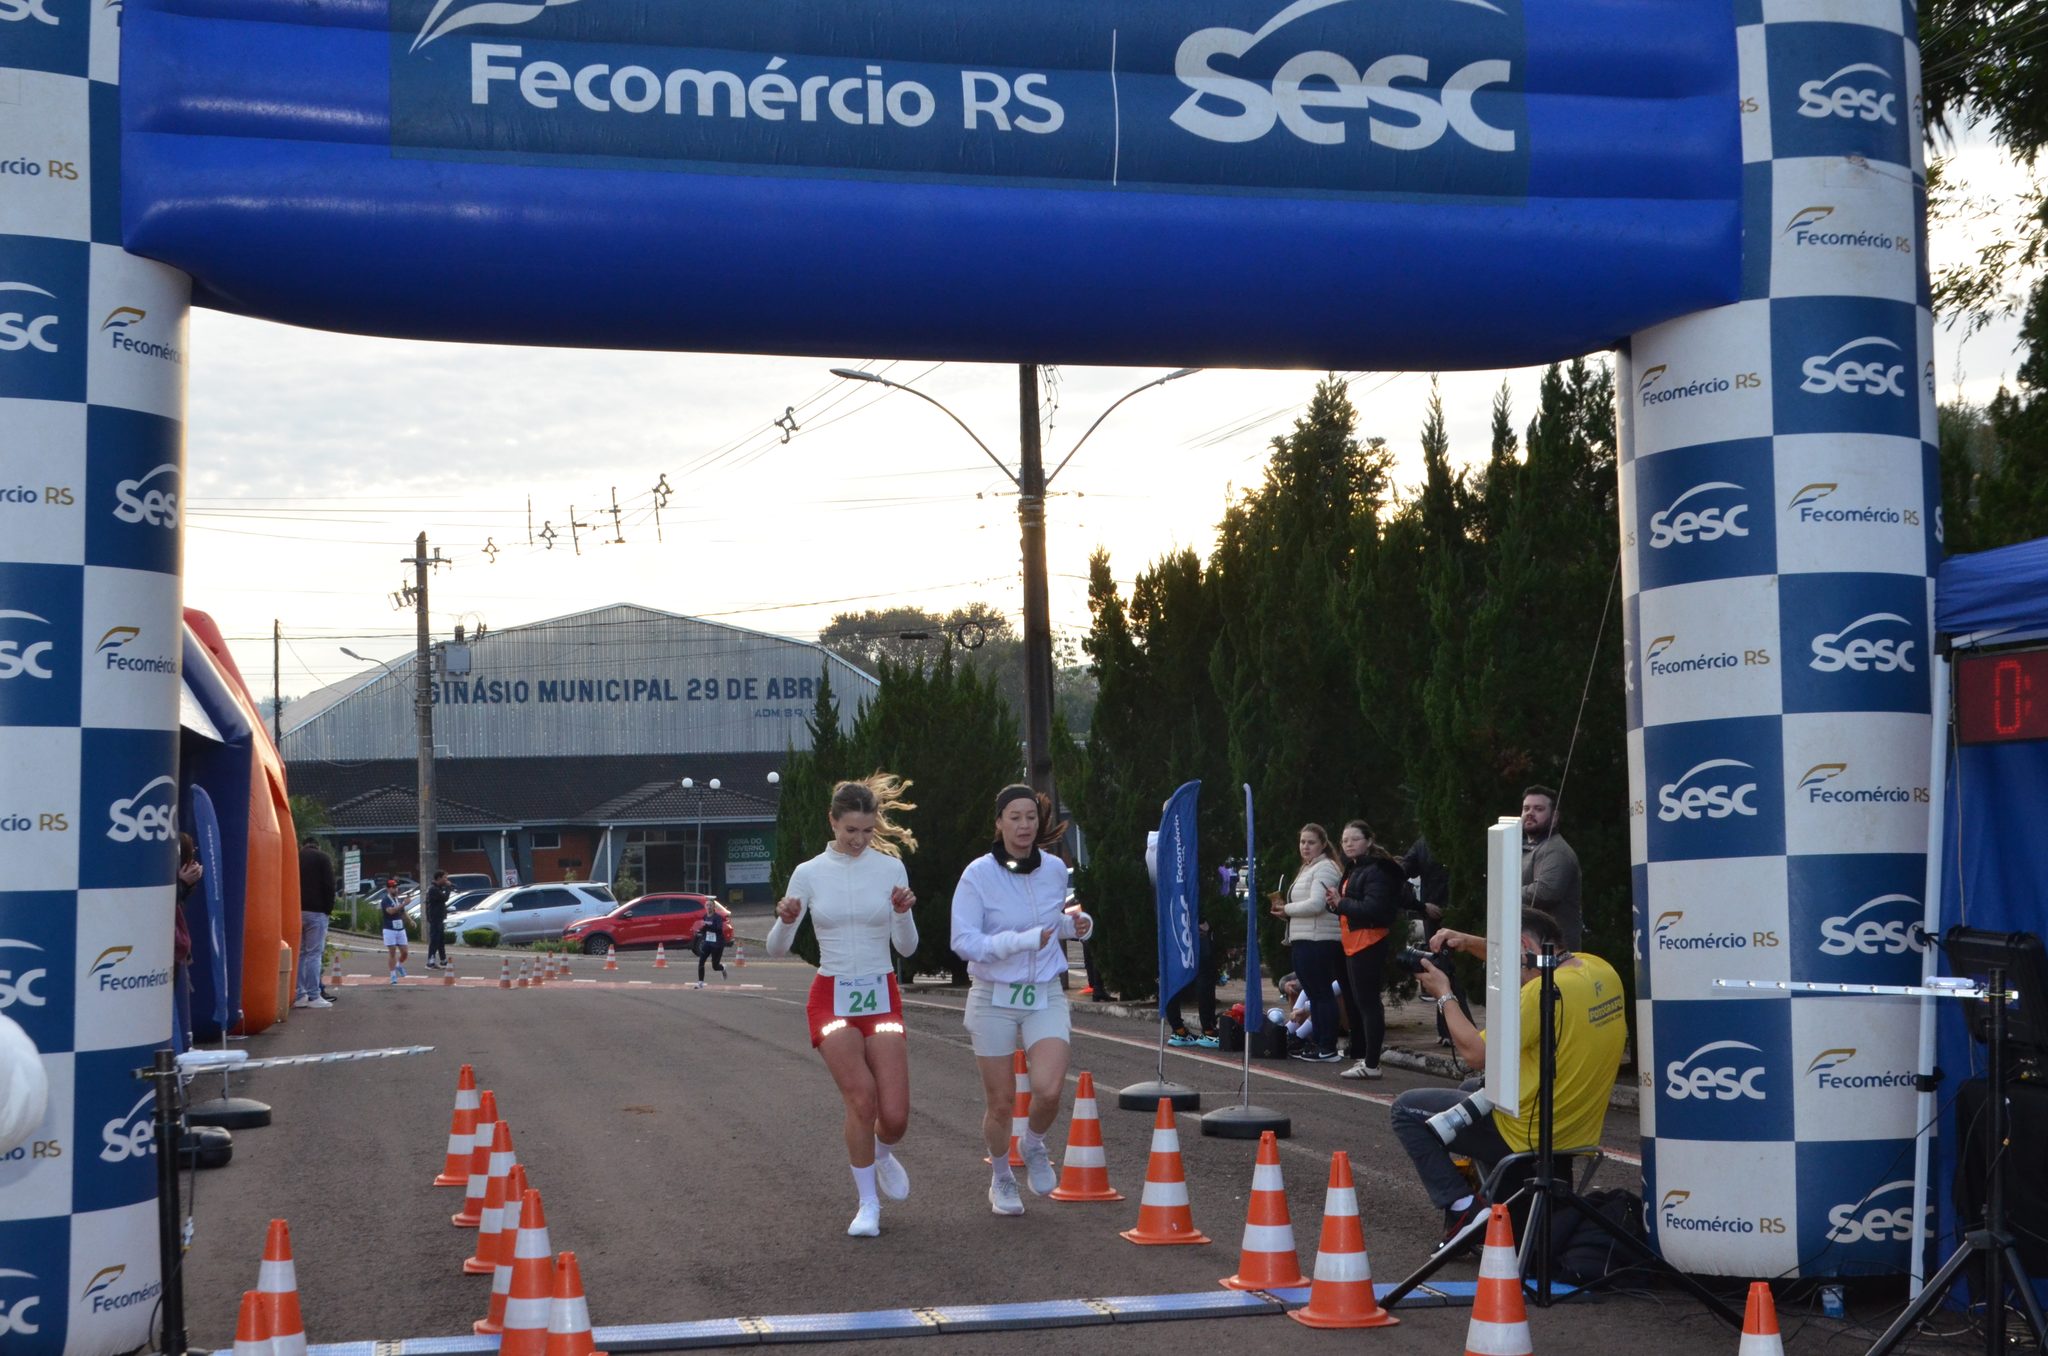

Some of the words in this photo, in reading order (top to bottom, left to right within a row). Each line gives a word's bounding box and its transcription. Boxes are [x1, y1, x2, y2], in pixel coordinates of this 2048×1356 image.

[471, 42, 936, 128] Fecomércio
[961, 70, 1065, 134] RS
[1169, 26, 1516, 152] Sesc
[1797, 79, 1897, 126] Sesc
[48, 160, 79, 180] RS
[1796, 230, 1893, 249] Fecomércio
[1895, 236, 1911, 253] RS
[1800, 355, 1905, 397] Sesc
[1643, 378, 1729, 407] Fecomércio
[1735, 372, 1761, 390] RS
[45, 486, 75, 506] RS
[1649, 504, 1749, 549] Sesc
[1801, 506, 1899, 524] Fecomércio
[1903, 509, 1920, 526] RS
[1651, 652, 1738, 676] Fecomércio
[1744, 649, 1771, 666] RS
[1809, 633, 1916, 673] Sesc
[538, 678, 678, 703] MUNICIPAL
[687, 678, 719, 700] 29
[727, 678, 758, 700] DE
[1658, 782, 1758, 822] Sesc
[1810, 786, 1910, 803] Fecomércio
[1914, 787, 1930, 803] RS
[39, 813, 69, 832] RS
[1659, 932, 1747, 950] Fecomércio
[1753, 931, 1779, 948] RS
[848, 989, 878, 1013] 24
[1009, 983, 1036, 1007] 76
[1666, 1061, 1766, 1100] Sesc
[32, 1139, 62, 1160] RS
[1666, 1213, 1754, 1233] Fecomércio
[1760, 1217, 1787, 1234] RS
